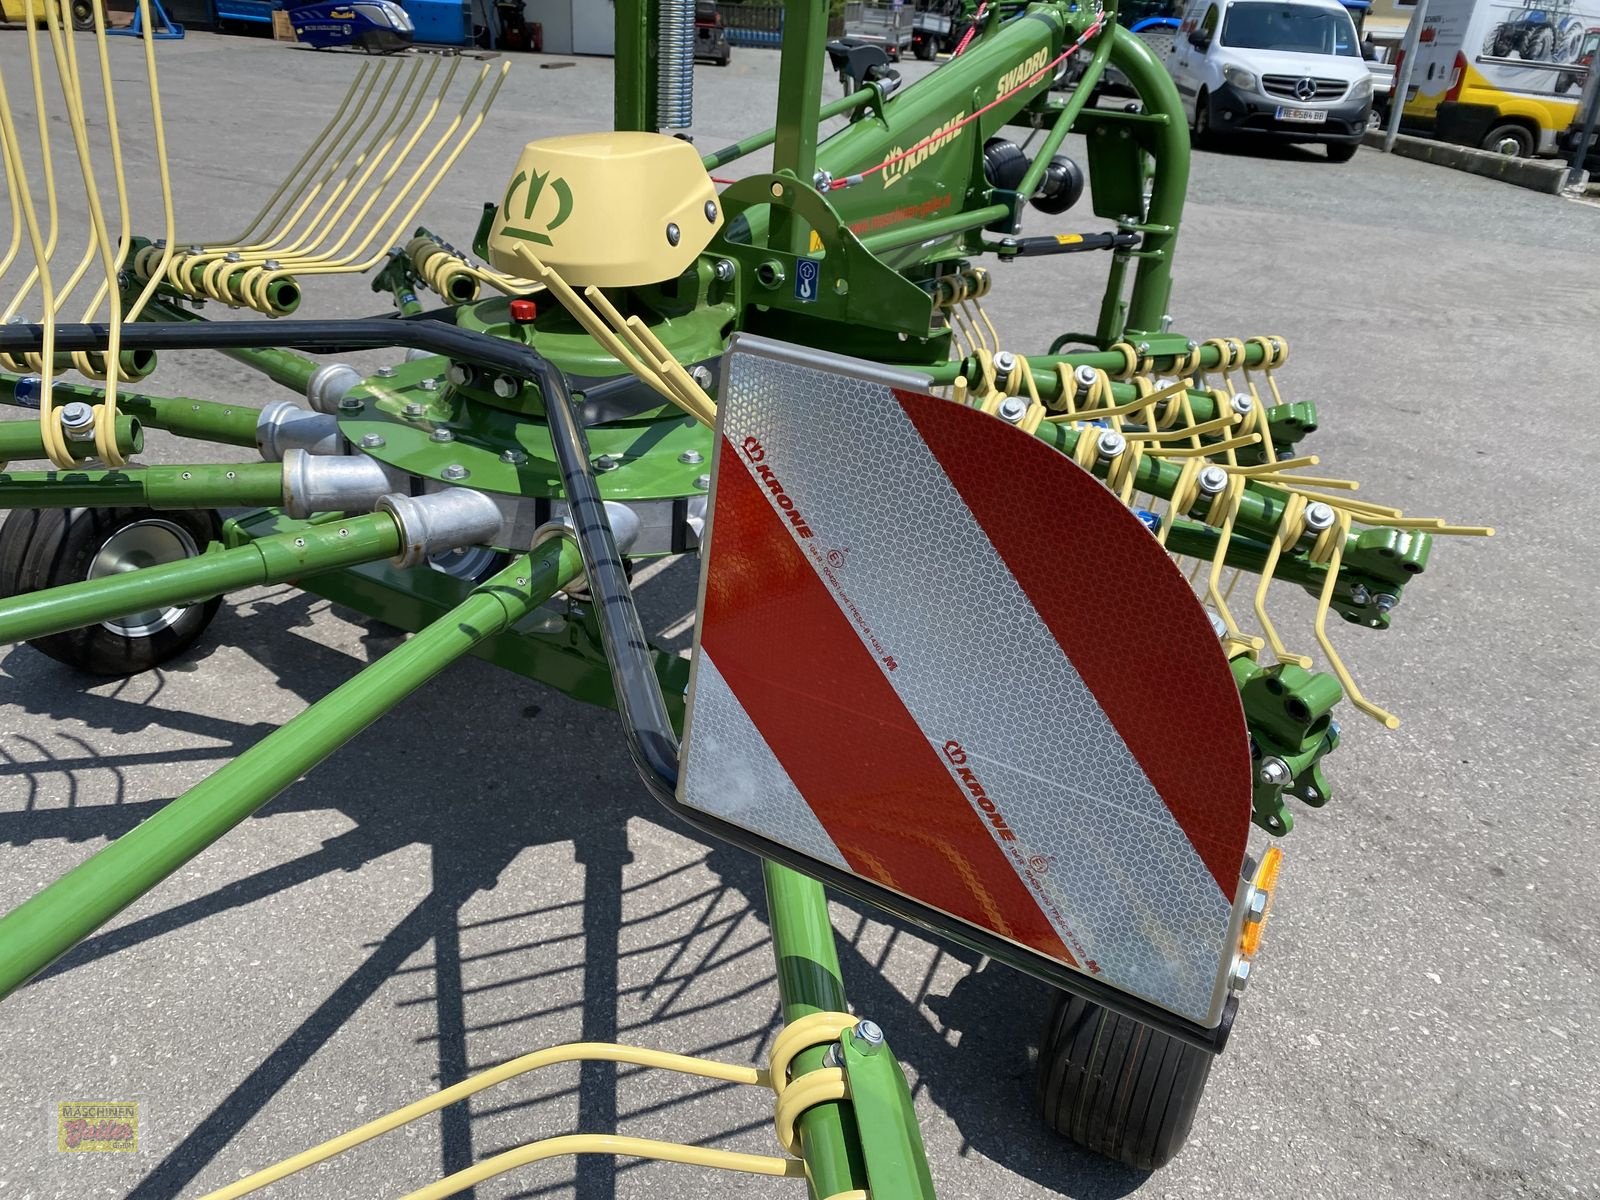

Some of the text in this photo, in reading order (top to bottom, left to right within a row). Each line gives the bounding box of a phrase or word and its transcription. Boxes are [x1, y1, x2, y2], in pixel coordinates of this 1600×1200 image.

[996, 46, 1048, 101] SWADRO
[903, 111, 965, 176] KRONE
[756, 465, 814, 539] KRONE
[956, 767, 1017, 841] KRONE
